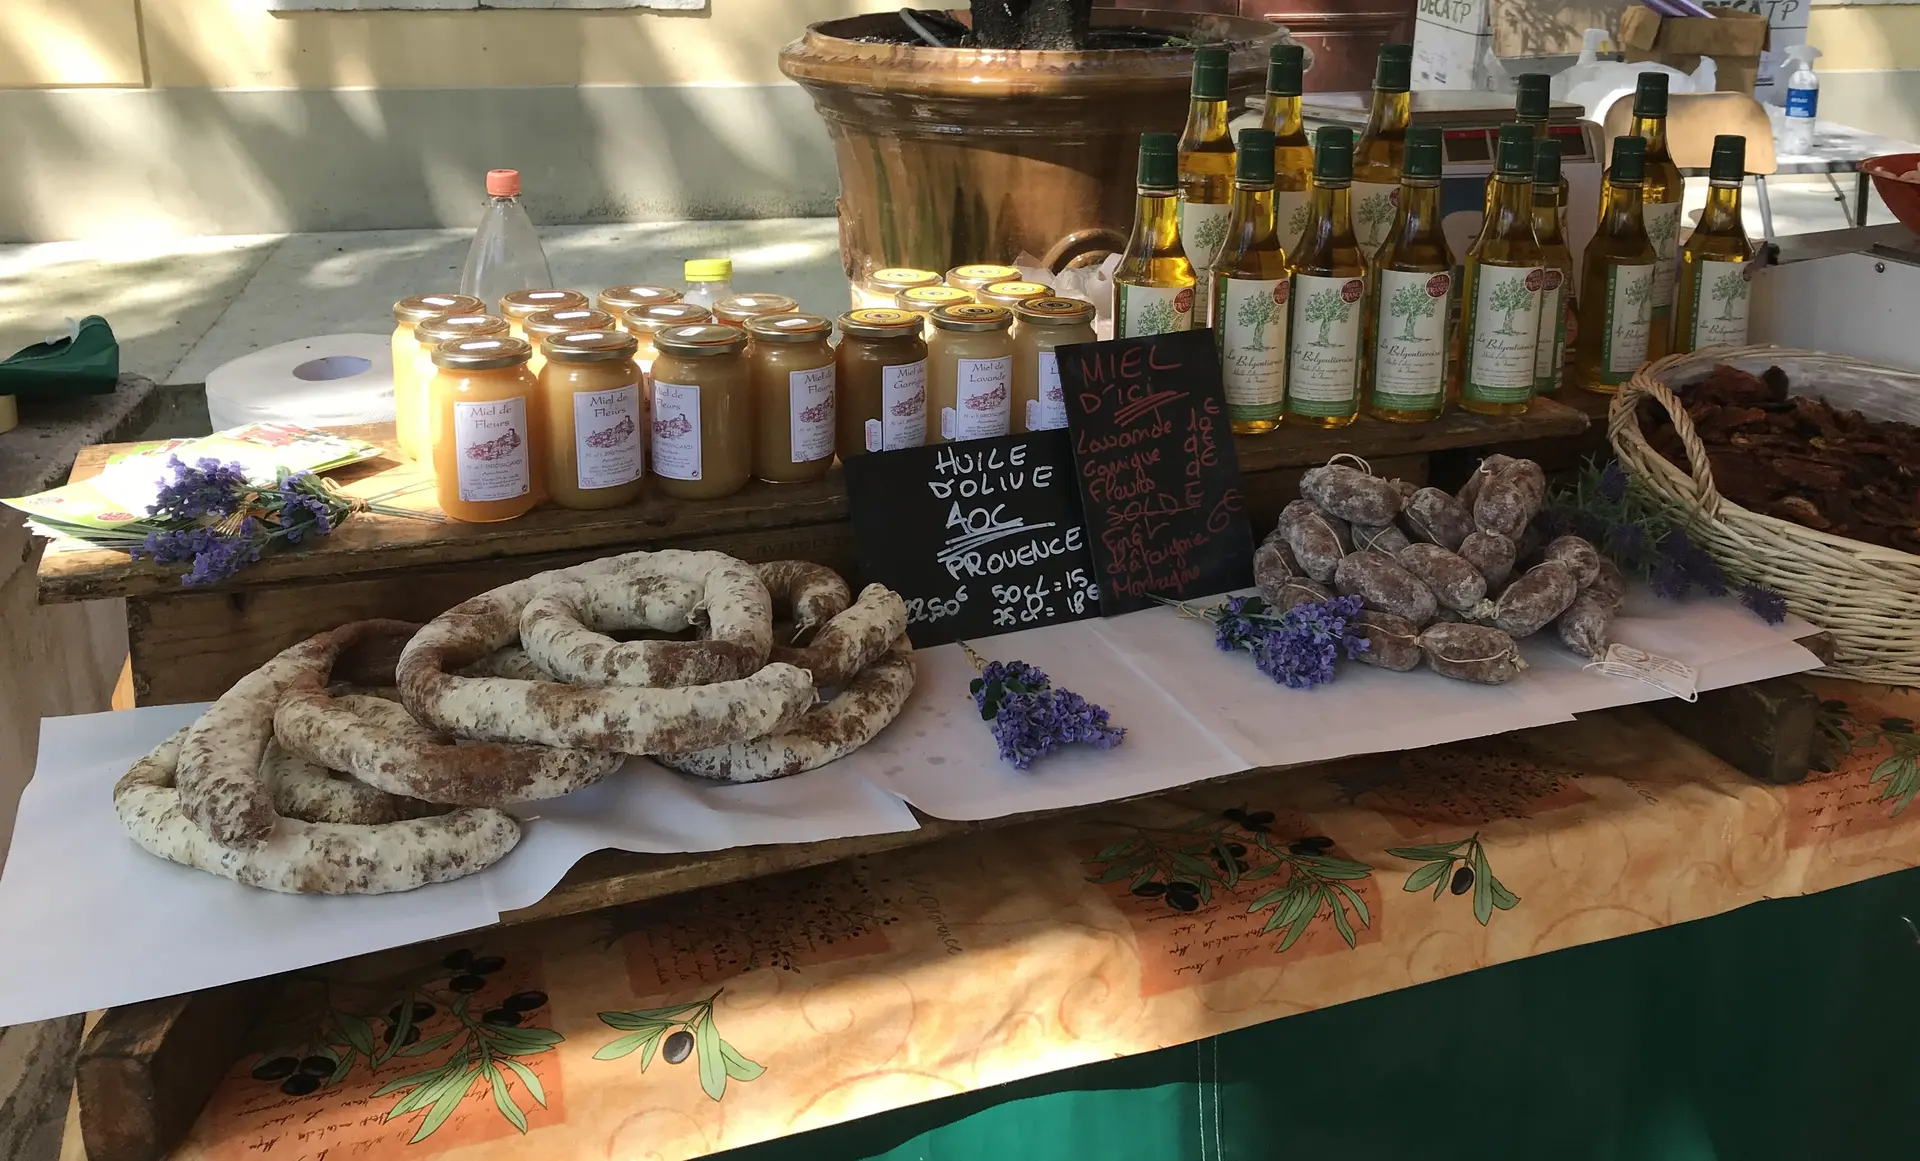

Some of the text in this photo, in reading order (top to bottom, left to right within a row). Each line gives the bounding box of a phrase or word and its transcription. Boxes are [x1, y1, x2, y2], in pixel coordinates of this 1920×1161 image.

[972, 361, 1004, 372] Miel de
[1080, 345, 1181, 387] MIEL
[804, 373, 824, 384] Miel
[897, 368, 916, 379] Miel
[969, 373, 1006, 383] Lavande
[672, 388, 683, 399] de
[590, 393, 628, 407] Miel de
[470, 404, 512, 417] Miel de
[595, 407, 627, 418] Fleurs
[474, 419, 510, 429] Fleurs
[1076, 407, 1172, 454] Lavande
[934, 444, 1028, 476] HUILE
[945, 501, 1022, 535] AOC
[945, 526, 1083, 581] PROVENCE
